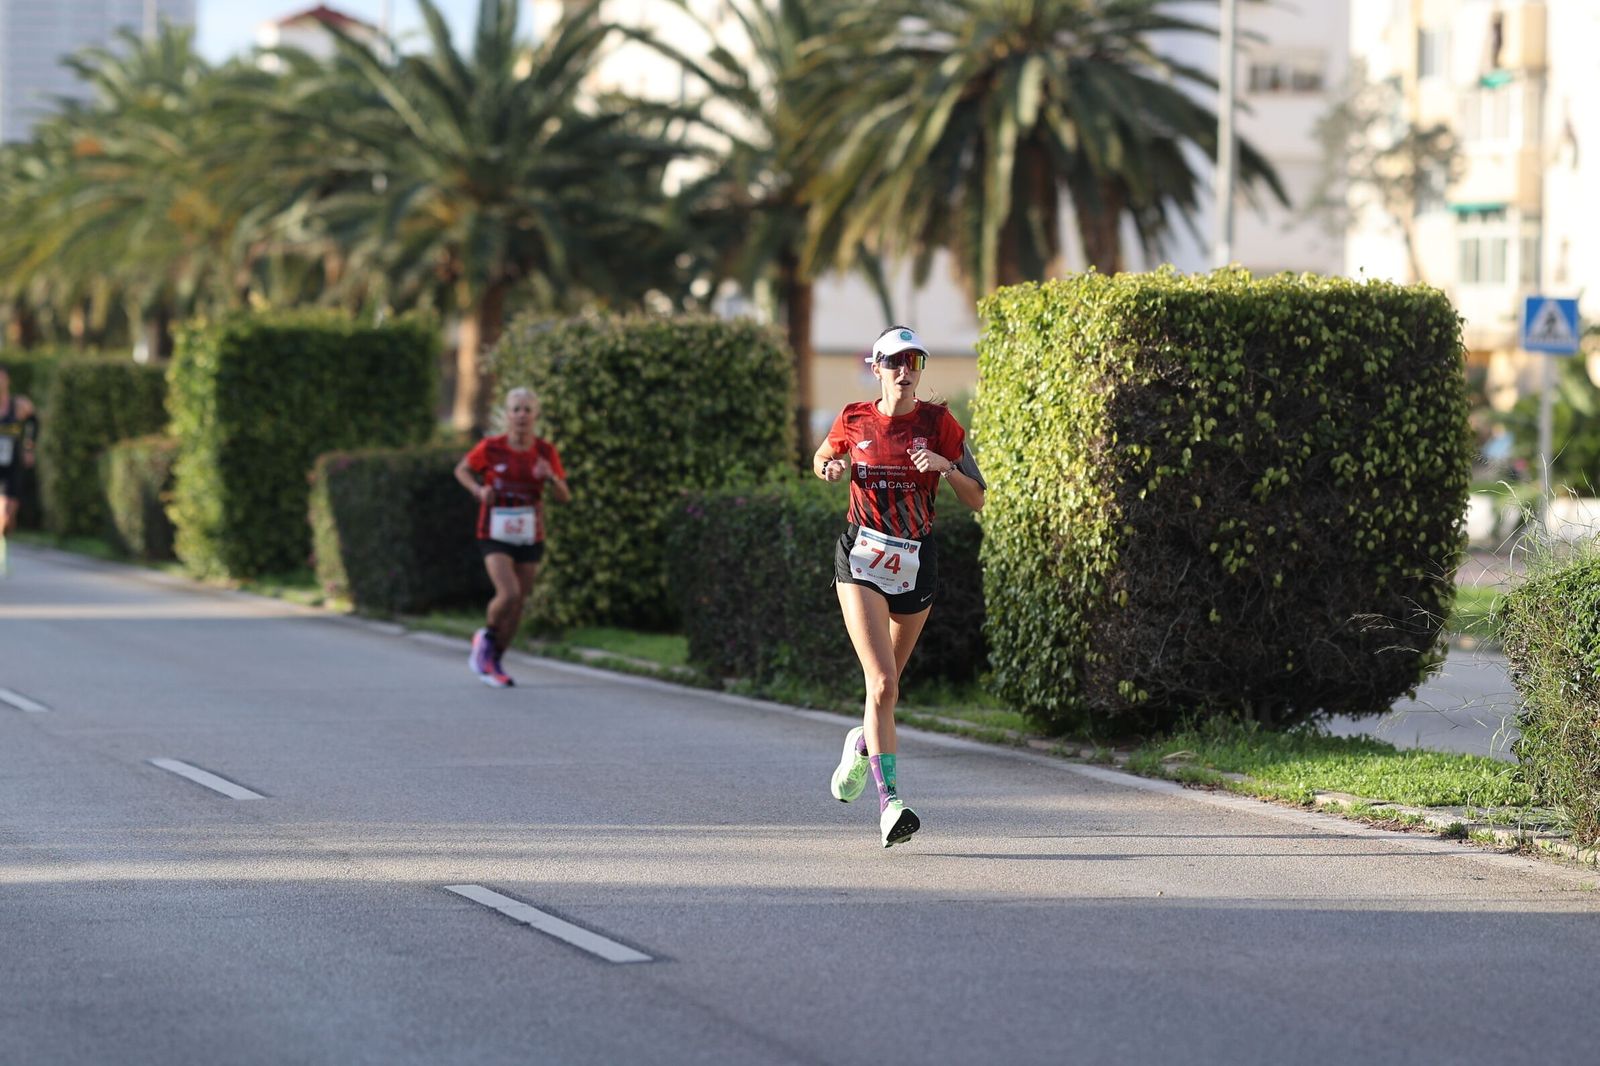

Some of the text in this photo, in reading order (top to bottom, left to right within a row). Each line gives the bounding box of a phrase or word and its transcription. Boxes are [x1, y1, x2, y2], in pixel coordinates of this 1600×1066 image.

[865, 481, 916, 489] LA CASA
[869, 547, 901, 575] 74
